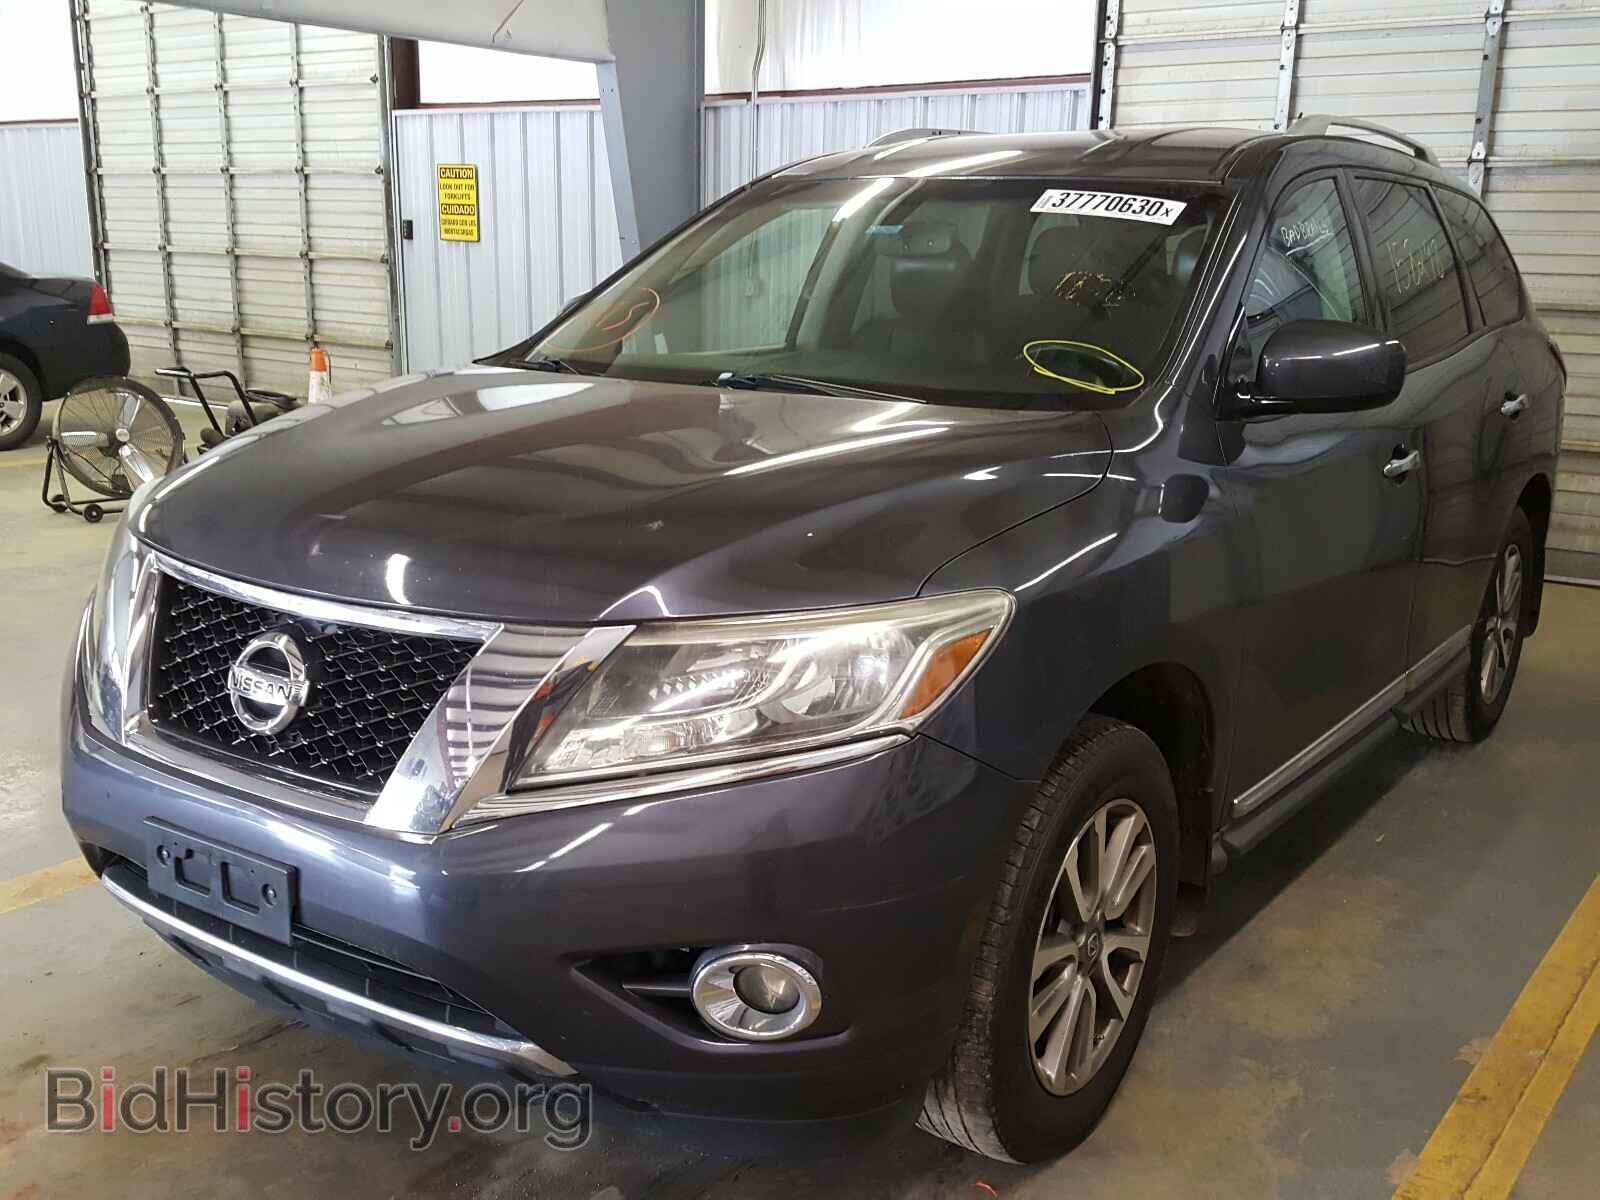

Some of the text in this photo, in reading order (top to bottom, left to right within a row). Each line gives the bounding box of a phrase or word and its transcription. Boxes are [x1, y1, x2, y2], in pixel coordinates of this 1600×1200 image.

[441, 169, 473, 178] CAUTION
[440, 183, 452, 191] LOOK
[465, 184, 475, 192] FOR
[442, 205, 475, 214] CUIDADO
[231, 669, 292, 700] NISSAN
